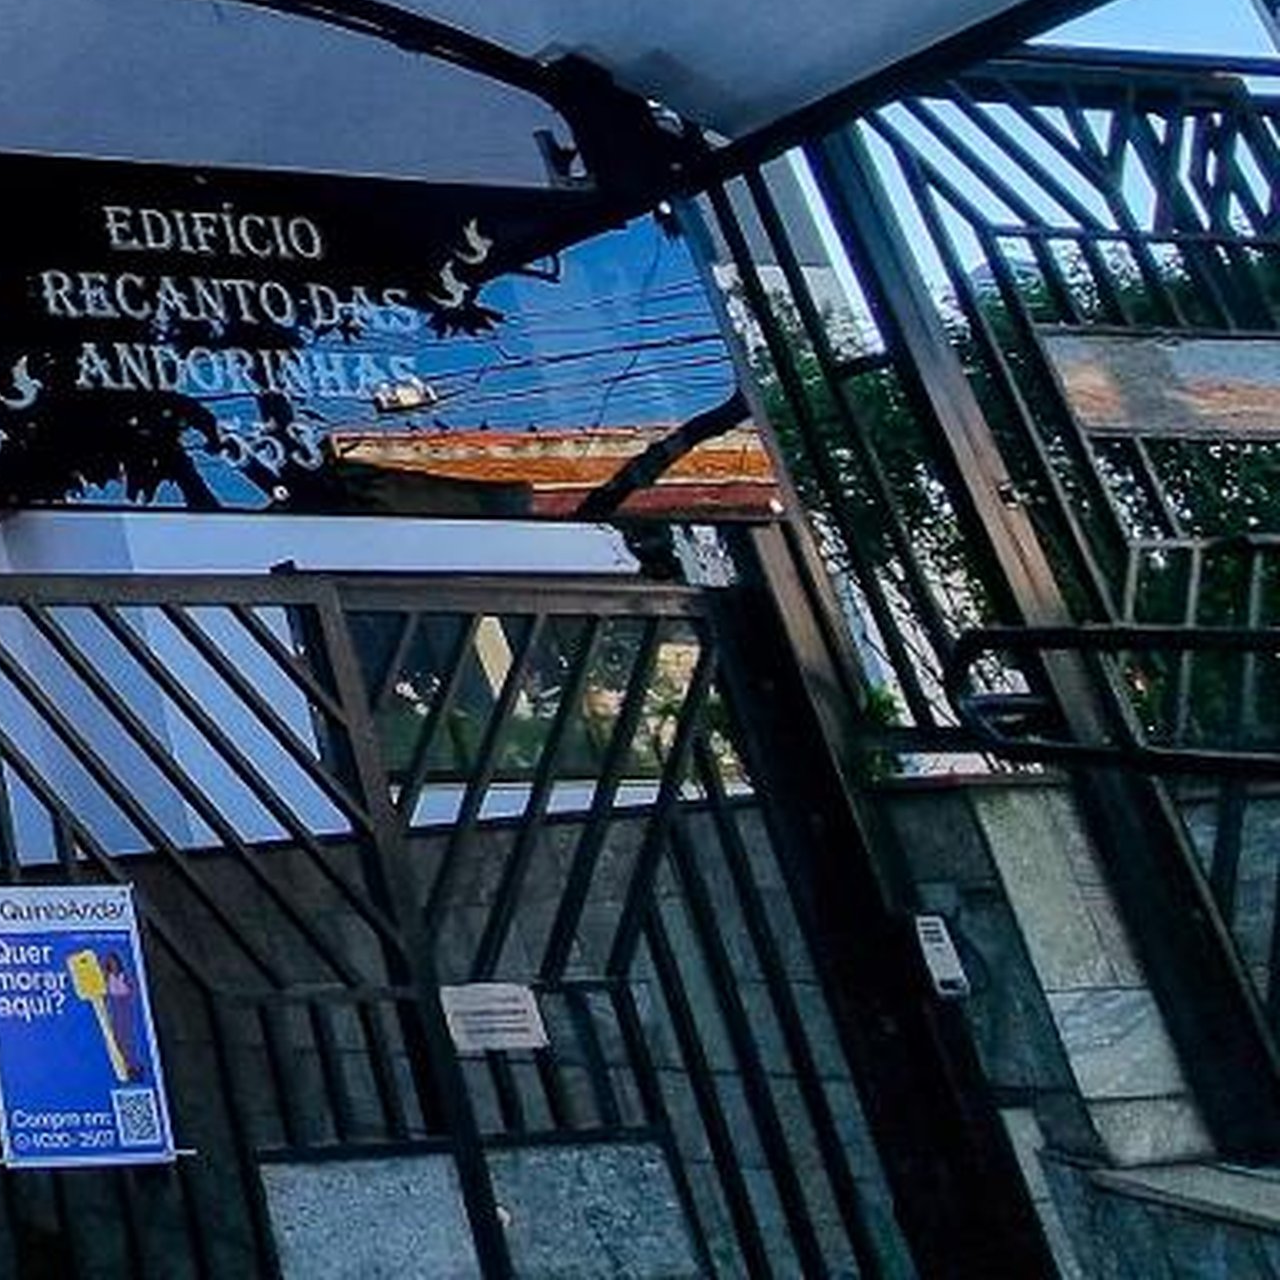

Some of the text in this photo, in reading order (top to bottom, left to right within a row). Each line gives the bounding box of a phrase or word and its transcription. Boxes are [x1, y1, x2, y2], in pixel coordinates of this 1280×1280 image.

[102, 203, 325, 260] EDIFÍCIO
[40, 270, 296, 329] RECANTO
[75, 342, 425, 399] ANDORINHAS
